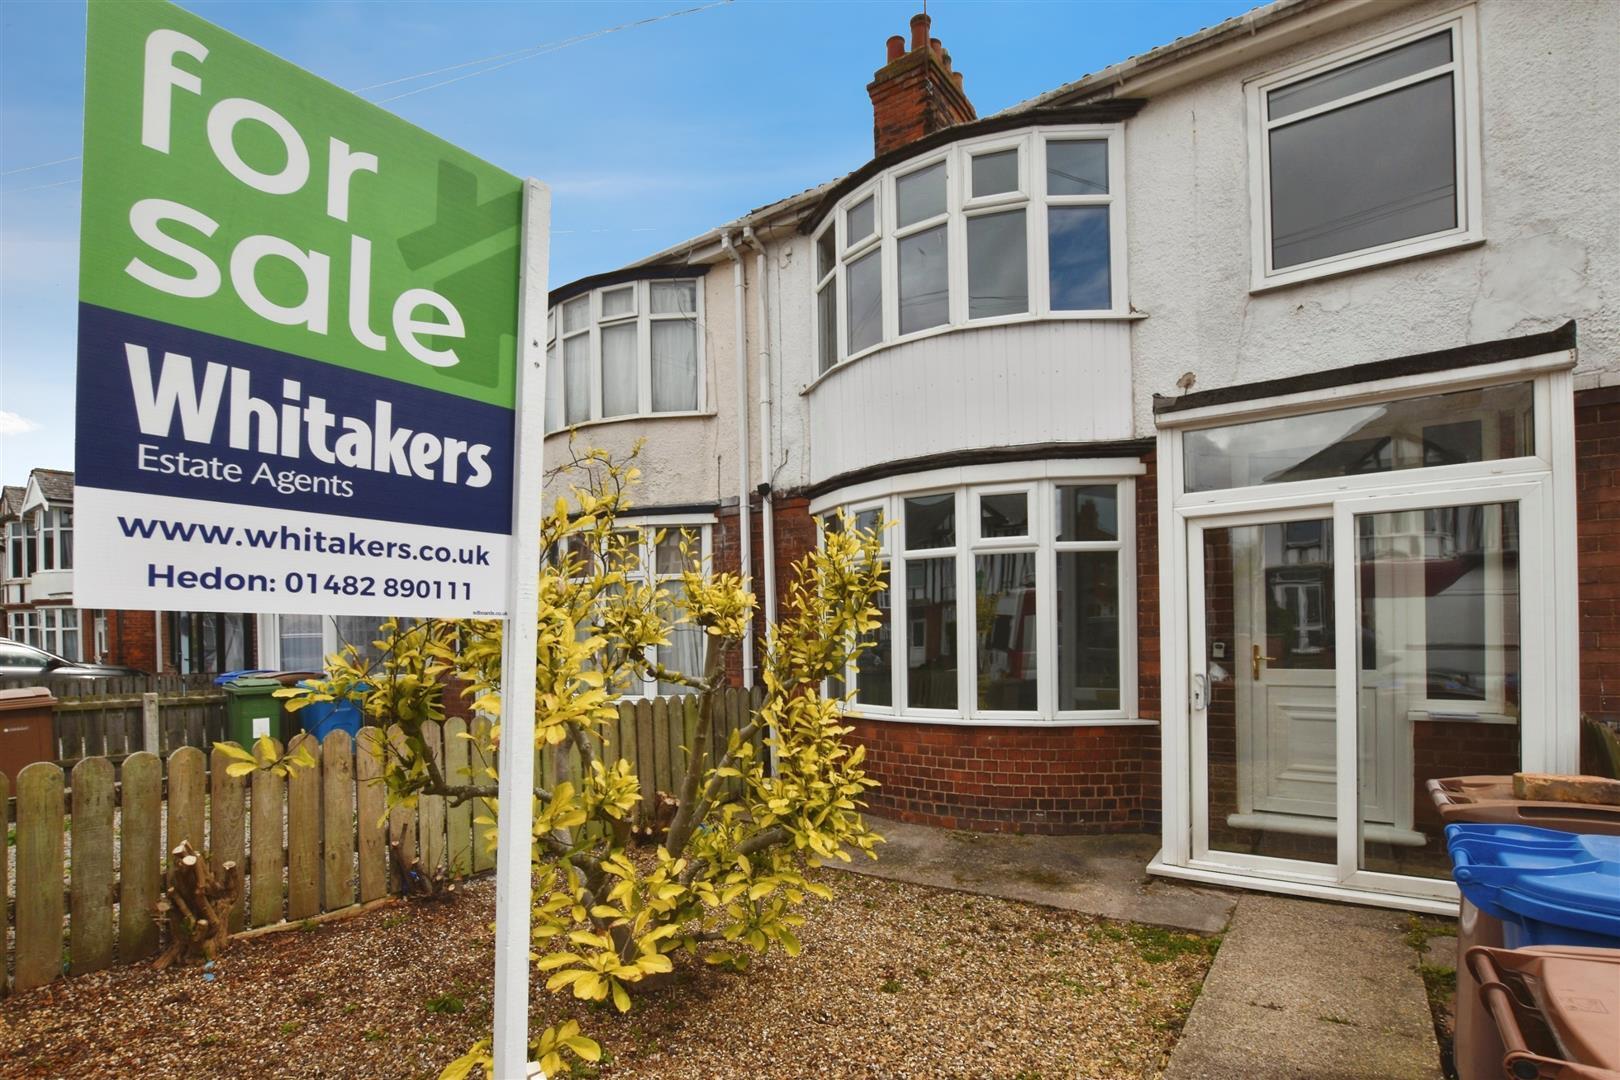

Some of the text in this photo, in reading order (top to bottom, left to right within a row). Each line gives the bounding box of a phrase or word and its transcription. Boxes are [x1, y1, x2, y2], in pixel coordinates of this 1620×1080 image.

[141, 28, 379, 223] for
[124, 198, 466, 368] sale
[124, 342, 492, 488] Whitakers
[138, 443, 354, 498] Estate Agents
[117, 515, 490, 566] www.whitakers.co.uk
[148, 563, 471, 601] Hedon: 01482 890111
